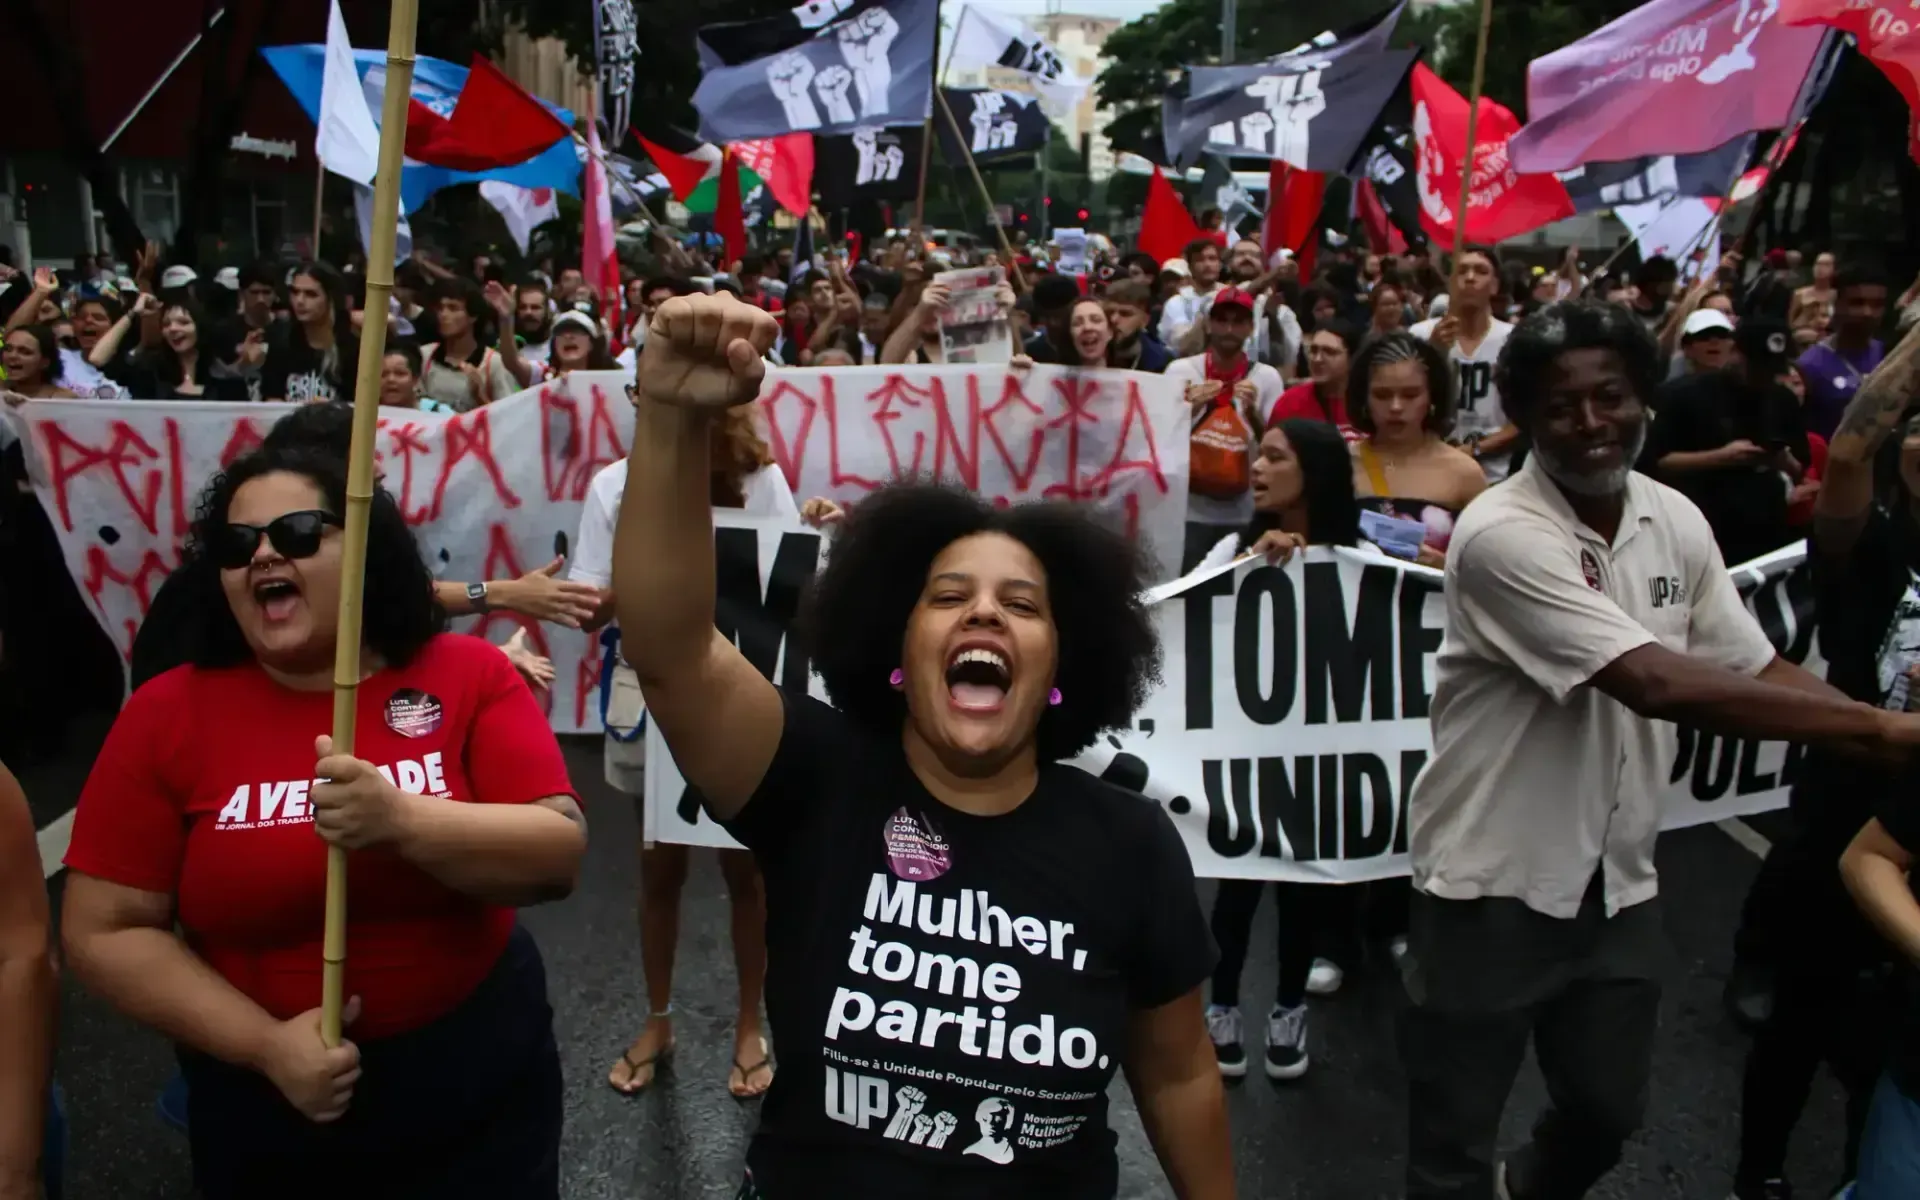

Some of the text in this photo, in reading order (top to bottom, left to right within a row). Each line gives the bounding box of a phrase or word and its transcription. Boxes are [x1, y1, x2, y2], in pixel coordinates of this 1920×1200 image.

[539, 384, 629, 503] DA
[1648, 576, 1669, 608] UP
[1166, 562, 1444, 730] TOME
[390, 704, 424, 712] CONTRA
[217, 784, 251, 823] A
[894, 816, 919, 826] LUTE
[226, 823, 256, 831] JORNAL
[257, 820, 275, 828] DOS
[892, 825, 942, 842] CONTRA O
[862, 872, 1089, 971] Mulher,
[846, 925, 1022, 1003] tome
[823, 986, 1110, 1070] partido.
[823, 1046, 870, 1068] Filie-se
[872, 1058, 880, 1070] à
[883, 1061, 944, 1081] Unidade
[946, 1072, 1003, 1091] Popular
[1003, 1085, 1036, 1098] pelo
[824, 1064, 889, 1130] UP
[1018, 1136, 1043, 1149] Olga
[1020, 1123, 1081, 1138] Mulheres
